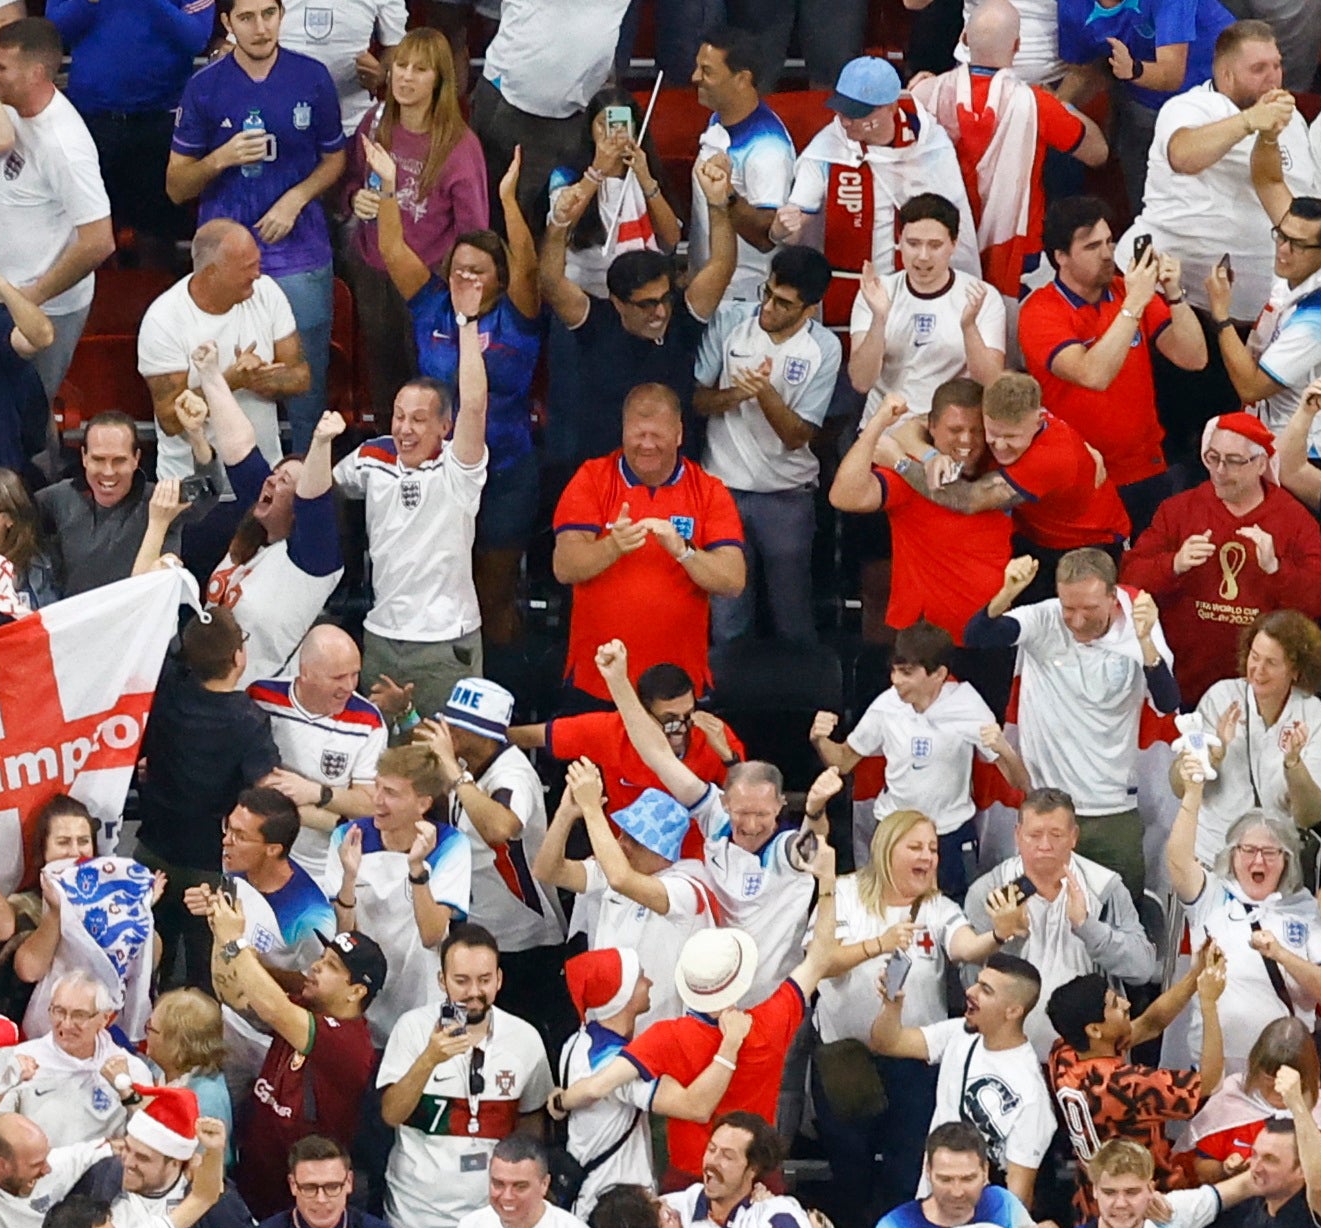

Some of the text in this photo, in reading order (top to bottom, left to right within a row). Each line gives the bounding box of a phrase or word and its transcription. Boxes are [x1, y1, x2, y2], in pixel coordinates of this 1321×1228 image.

[1212, 603, 1242, 615] WORLD
[1242, 606, 1260, 618] CUP
[429, 1099, 447, 1132] 7
